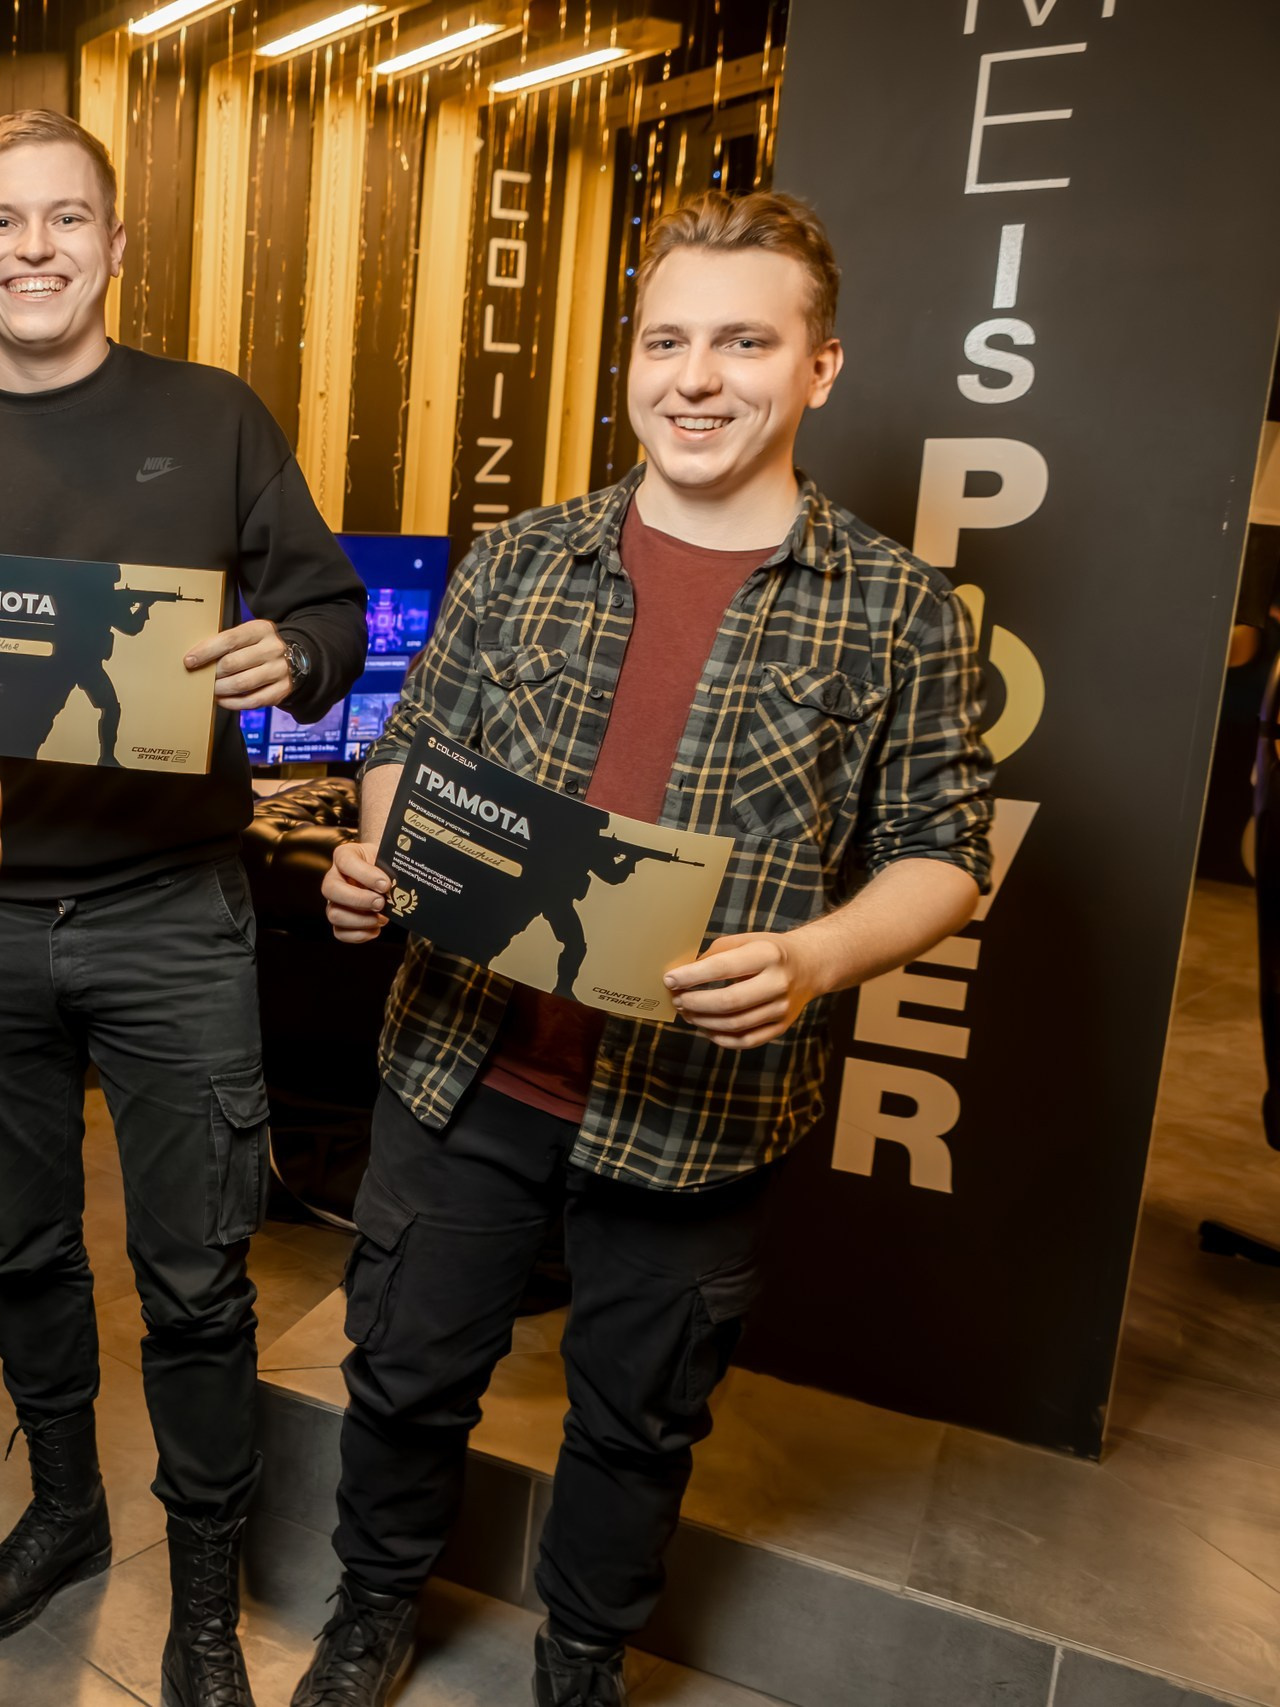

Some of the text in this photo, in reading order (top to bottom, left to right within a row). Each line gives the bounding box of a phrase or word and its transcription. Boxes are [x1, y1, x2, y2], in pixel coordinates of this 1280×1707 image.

[956, 223, 1038, 404] IS
[143, 457, 175, 471] NIKE
[131, 746, 175, 755] COUNTER
[137, 749, 191, 763] STRIKE 2
[435, 743, 478, 771] COLIZEUM
[415, 764, 531, 841] ГРАМОТА
[592, 986, 641, 1002] COUNTER
[598, 994, 635, 1007] STRIKE
